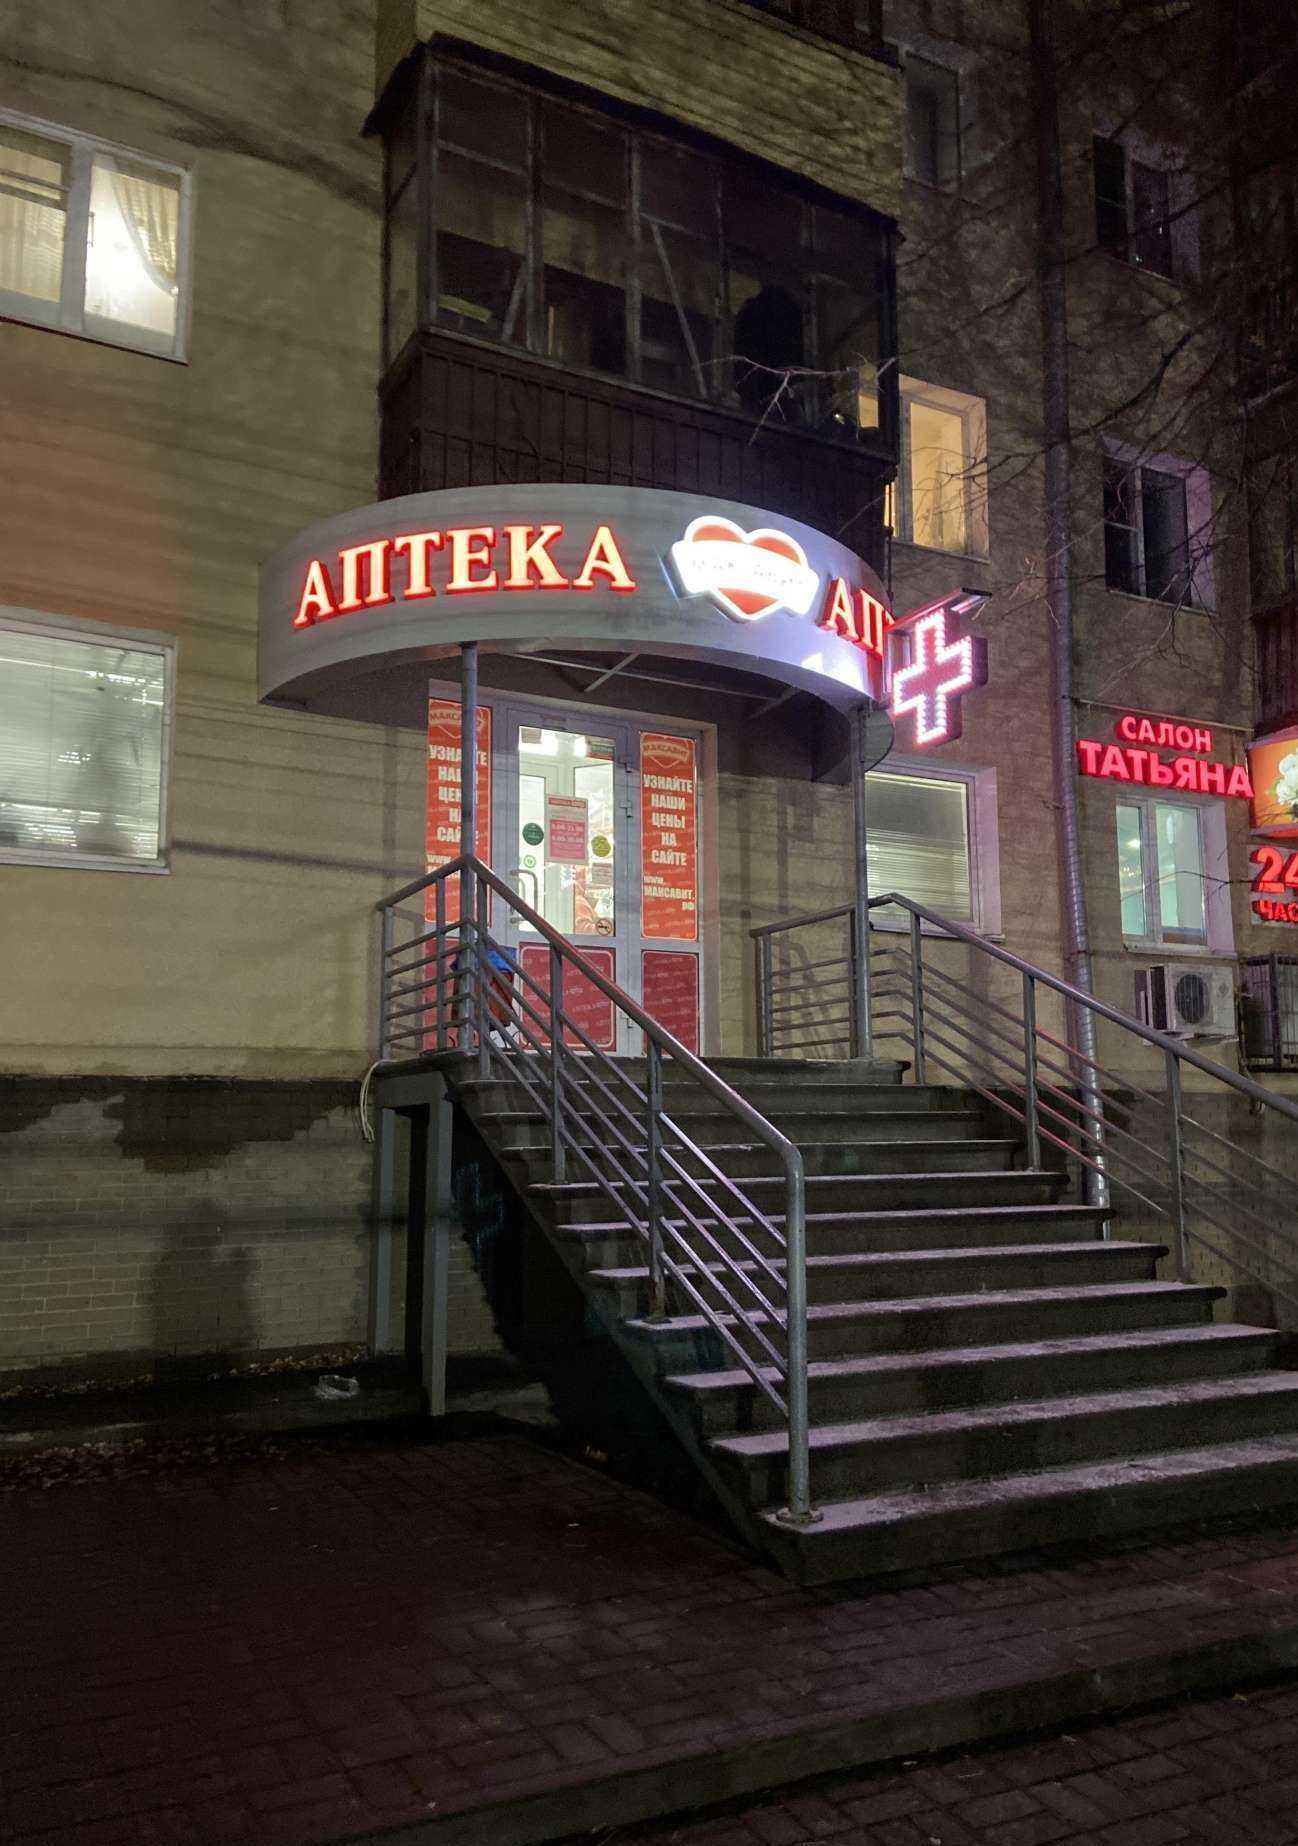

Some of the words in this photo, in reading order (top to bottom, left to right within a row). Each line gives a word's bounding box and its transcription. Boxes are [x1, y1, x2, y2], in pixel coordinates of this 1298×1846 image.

[294, 524, 637, 627] АПТЕКА
[816, 575, 896, 656] АП
[1117, 715, 1212, 753] САЛОН
[429, 744, 487, 766] УЗНАТЕ
[1077, 740, 1255, 798] ТАТЬЯНА
[643, 774, 693, 793] УЗНАЙТЕ
[651, 793, 686, 810] НАШИ
[652, 812, 686, 829] ЦЕНЫ
[661, 832, 677, 846] НА
[651, 849, 687, 866] САЙТЕ
